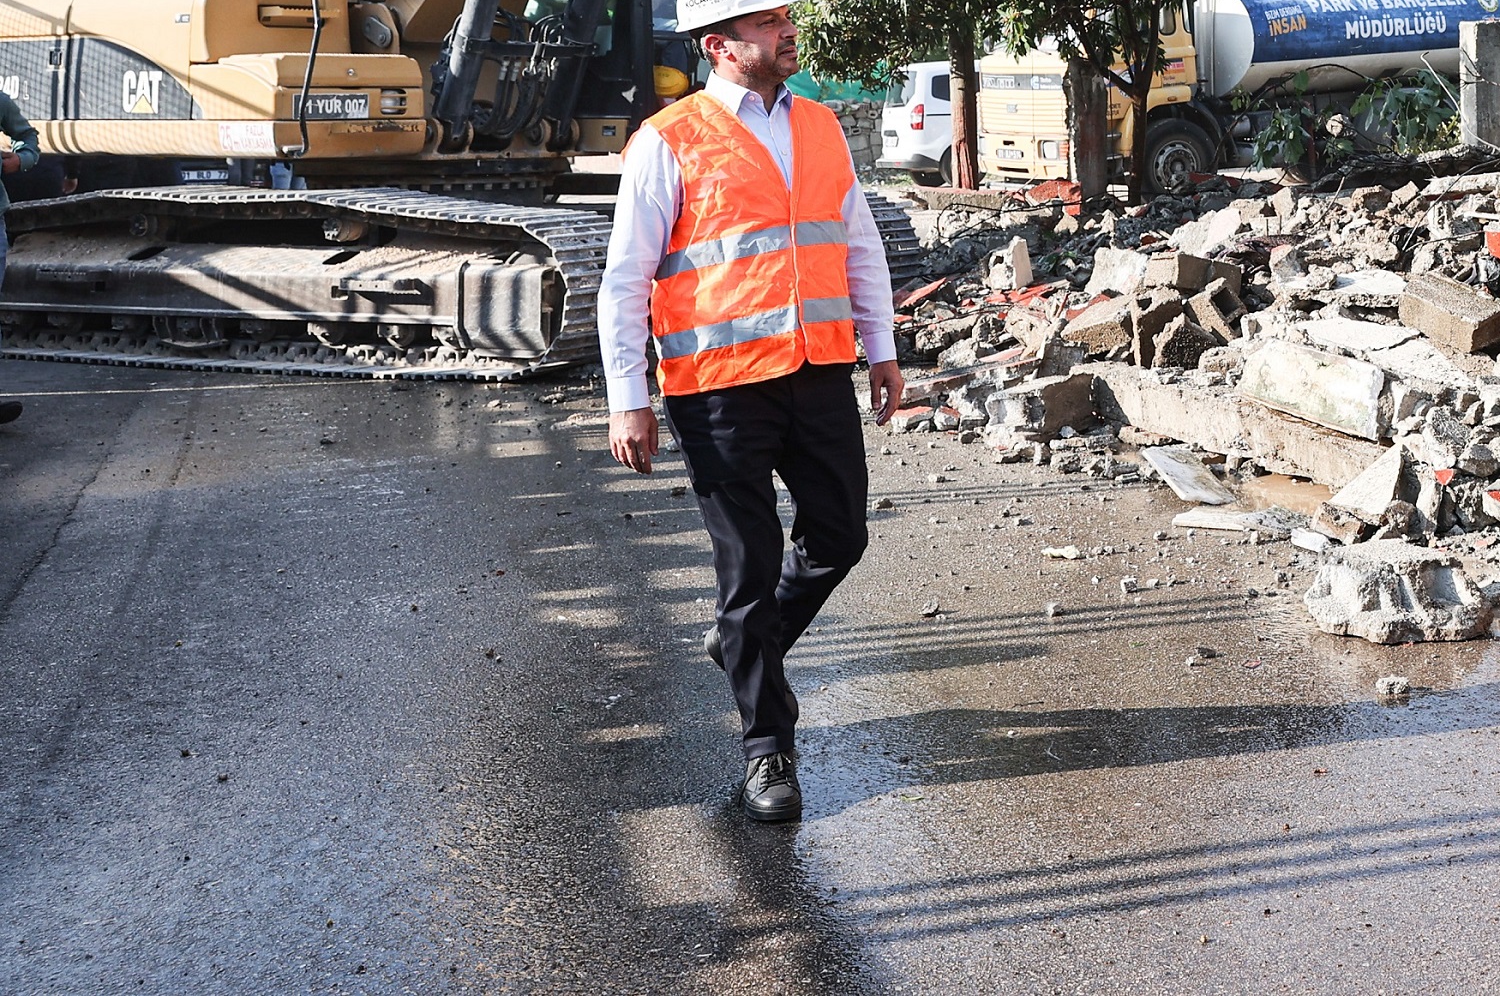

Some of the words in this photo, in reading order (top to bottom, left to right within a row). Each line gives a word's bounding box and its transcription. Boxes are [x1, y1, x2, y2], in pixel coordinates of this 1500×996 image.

[1345, 10, 1446, 40] MÜDÜRLÜĞÜ
[122, 70, 163, 114] CAT
[317, 98, 342, 114] YUR
[345, 98, 366, 114] 007
